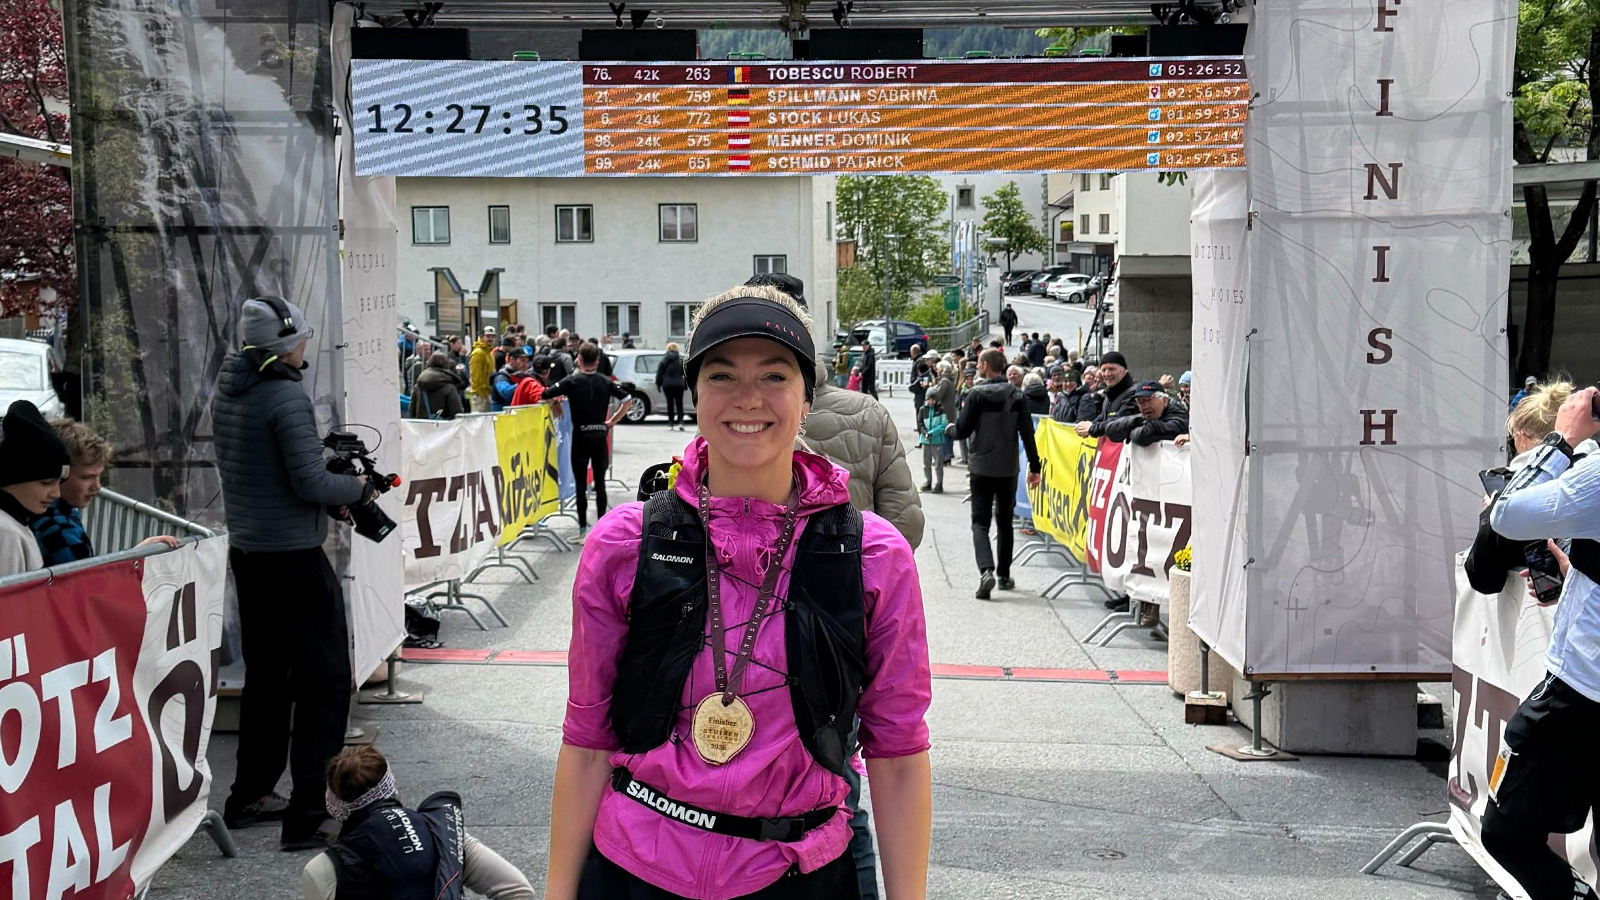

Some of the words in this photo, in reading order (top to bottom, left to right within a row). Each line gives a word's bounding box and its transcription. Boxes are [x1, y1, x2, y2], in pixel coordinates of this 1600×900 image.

[593, 68, 612, 81] 76.
[634, 70, 660, 80] 42K
[685, 68, 711, 81] 263
[767, 67, 844, 80] TOBESCU
[851, 66, 917, 80] ROBERT
[1168, 64, 1242, 76] 05:26:52
[635, 92, 661, 103] 24K
[686, 90, 711, 103] 759
[767, 89, 860, 103] SPILLMANN
[867, 89, 938, 102] SABRINA
[367, 103, 569, 136] 12:27:35
[635, 114, 661, 125] 24K
[687, 112, 711, 125] 772
[767, 111, 822, 124] STOCK
[828, 111, 881, 124] LUKAS
[1167, 108, 1240, 120] 01:59:35
[635, 136, 661, 147] 24K
[687, 135, 711, 147] 575
[767, 134, 836, 147] MENNER
[842, 133, 912, 146] DOMINIK
[637, 158, 661, 169] 24K
[688, 157, 711, 169] 651
[767, 156, 831, 169] SCHMID
[836, 155, 905, 168] PATRICK
[1166, 153, 1239, 164] 02:57:15
[1360, 0, 1403, 445] FINISH
[1211, 287, 1244, 304] MOVES
[651, 553, 694, 565] SALOMON
[0, 633, 133, 793] ÖTZ
[708, 716, 738, 727] Finisher
[626, 779, 717, 830] SALOMON
[0, 781, 132, 900] TAL
[453, 806, 464, 865] SALOMON
